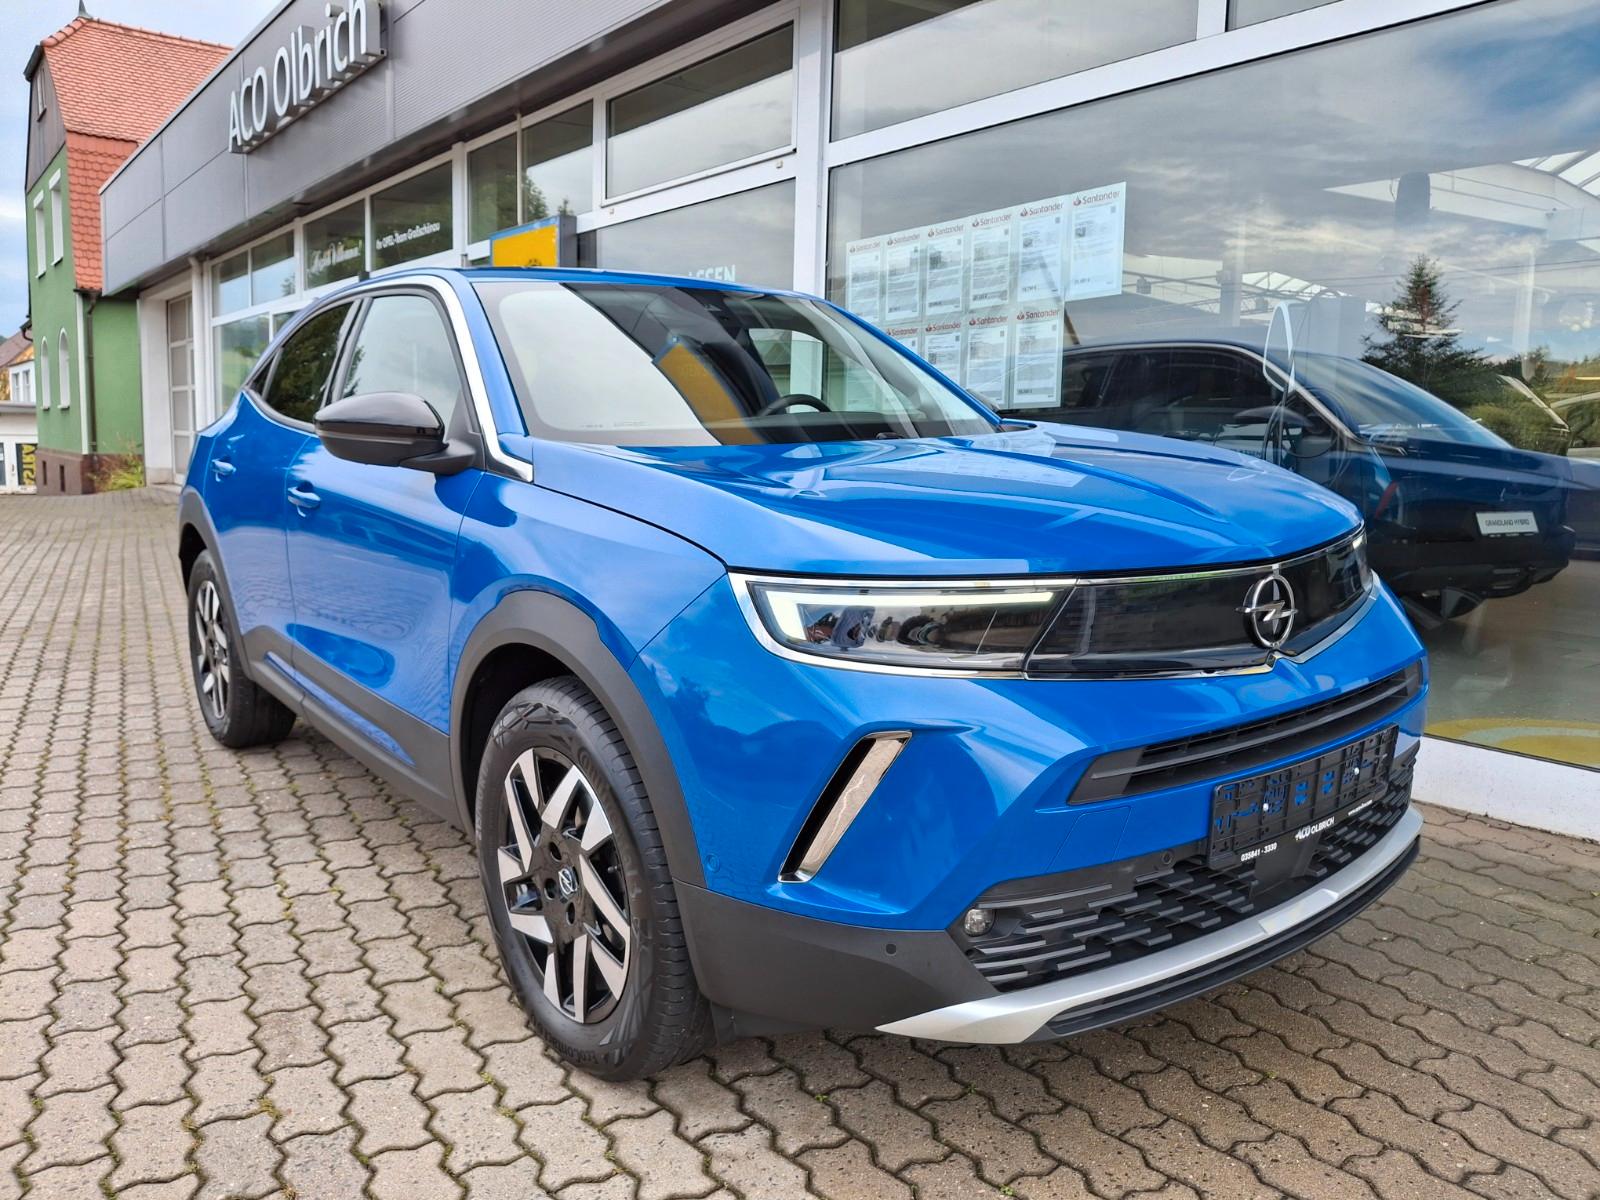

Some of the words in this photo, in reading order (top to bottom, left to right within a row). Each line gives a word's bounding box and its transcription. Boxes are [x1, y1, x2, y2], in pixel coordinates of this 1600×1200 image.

[229, 66, 268, 152] ACO
[273, 0, 367, 117] Olbrich
[1082, 190, 1121, 205] Santander
[1029, 202, 1064, 217] Santander
[976, 315, 1008, 326] Santander
[1025, 309, 1060, 320] Santander
[1311, 816, 1335, 834] OLBRICH
[1241, 849, 1261, 862] 035841
